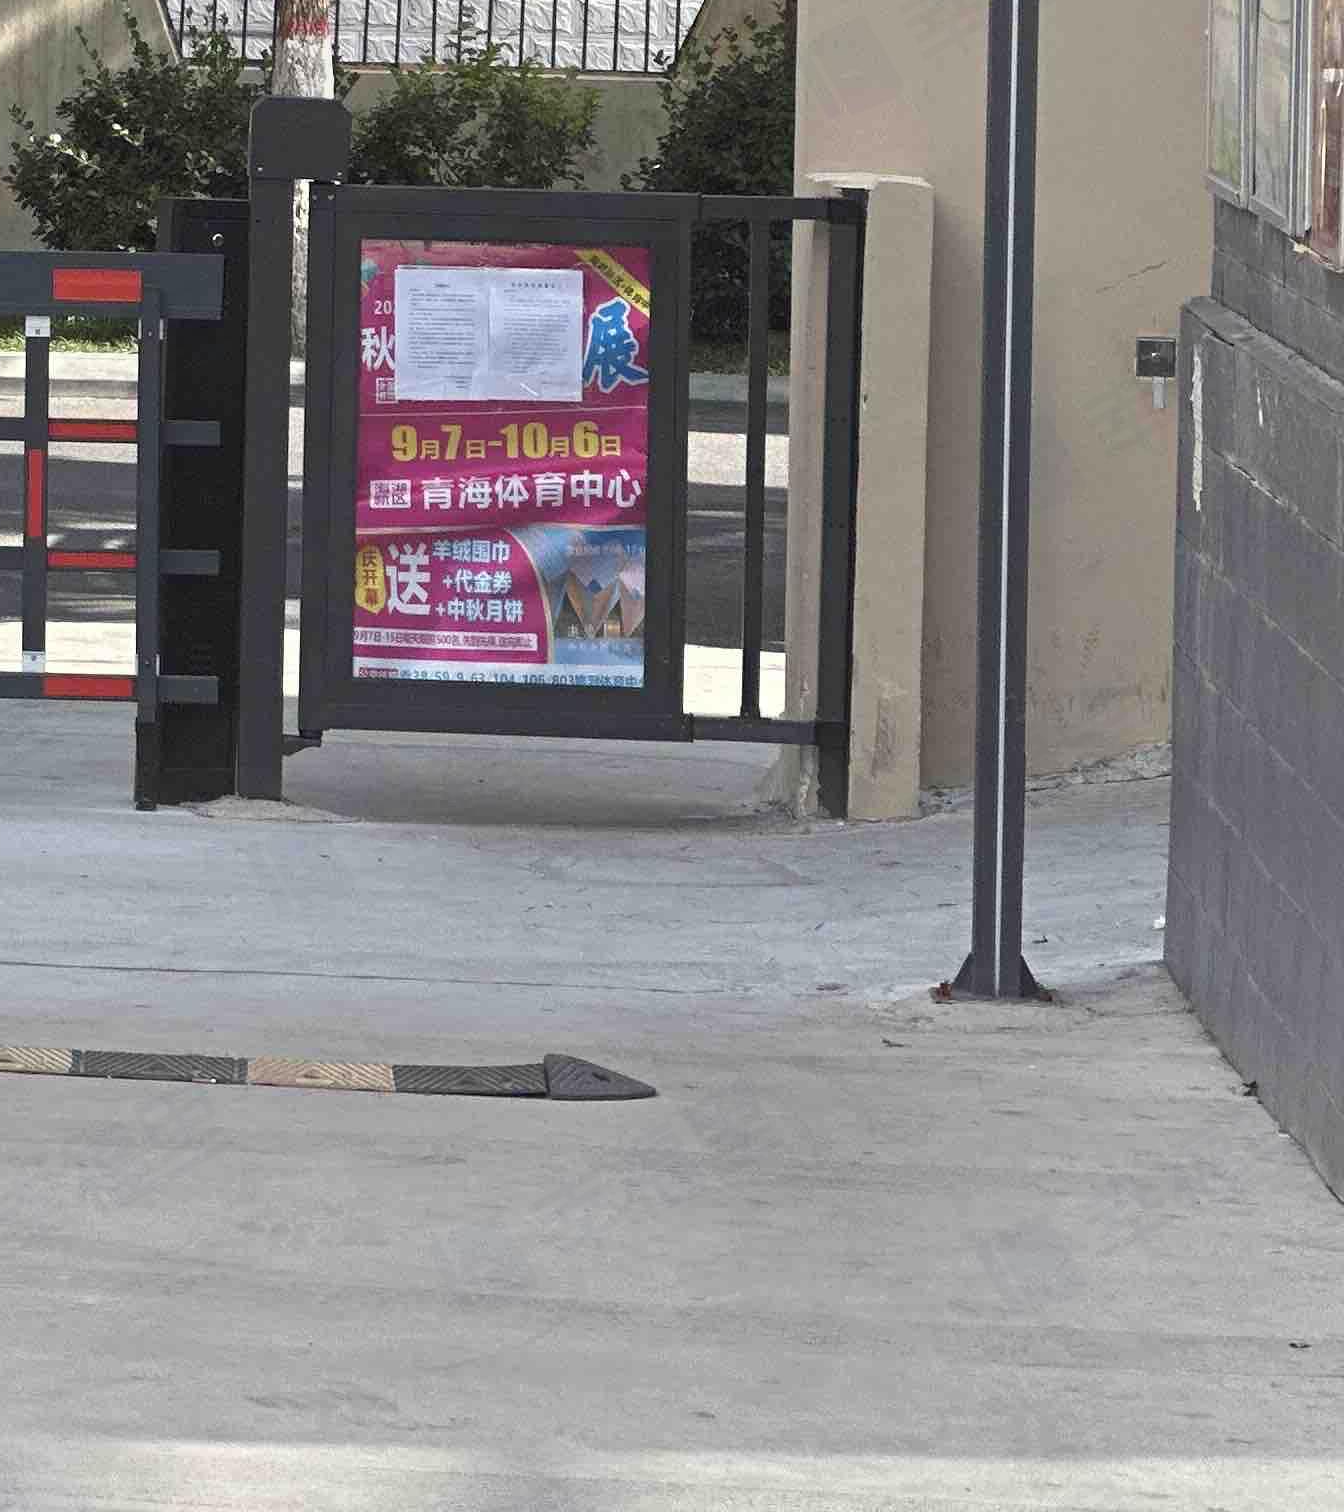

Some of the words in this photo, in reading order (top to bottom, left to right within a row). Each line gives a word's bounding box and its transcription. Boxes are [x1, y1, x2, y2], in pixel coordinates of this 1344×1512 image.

[391, 420, 622, 461] 9月7日-10月6日
[421, 469, 641, 510] 青海体育中心
[386, 543, 431, 616] 送
